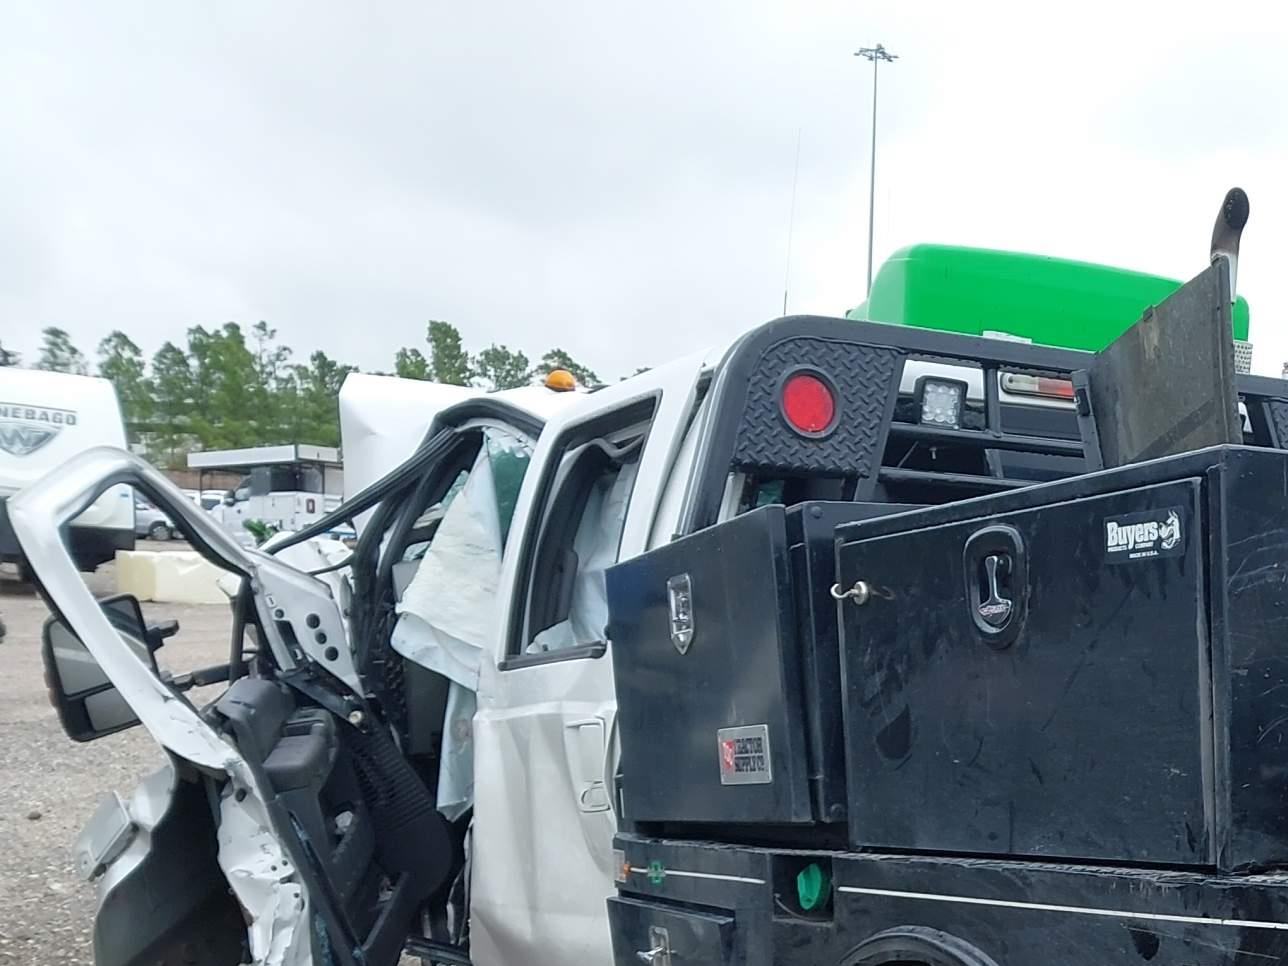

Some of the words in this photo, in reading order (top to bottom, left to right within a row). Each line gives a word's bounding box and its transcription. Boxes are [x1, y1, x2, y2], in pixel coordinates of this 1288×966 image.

[1106, 521, 1159, 550] Buyers
[734, 737, 763, 755] TRACTOR
[735, 754, 757, 773] SUPPLY
